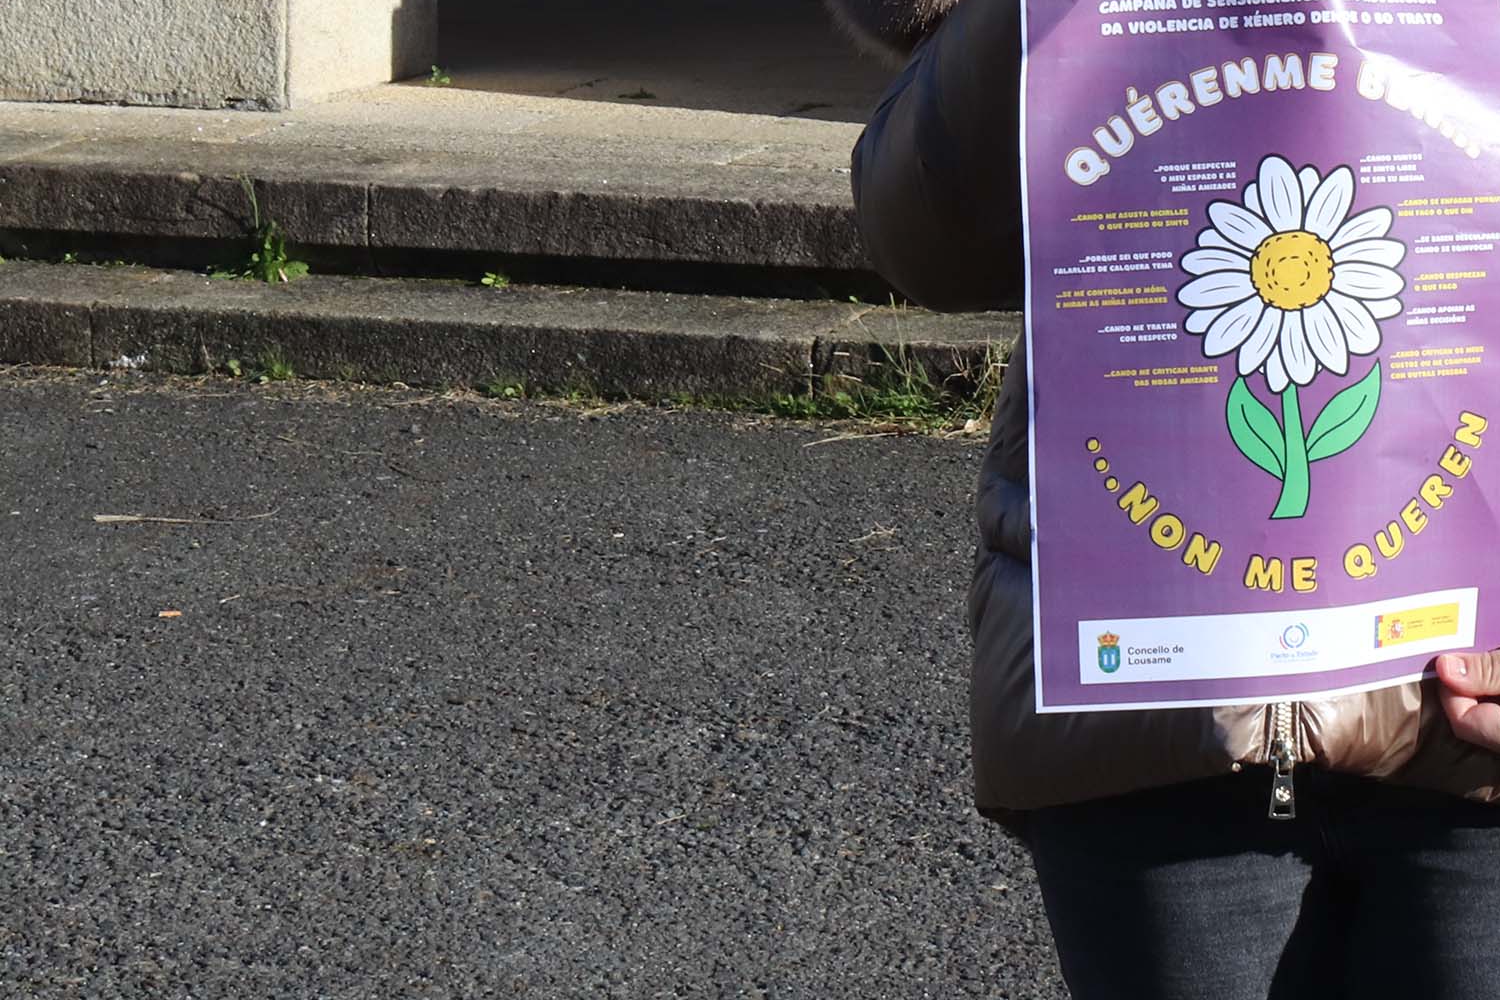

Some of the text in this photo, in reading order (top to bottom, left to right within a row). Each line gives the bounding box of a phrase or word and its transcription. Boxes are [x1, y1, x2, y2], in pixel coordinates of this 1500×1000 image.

[1101, 22, 1123, 36] DA
[1128, 18, 1214, 34] VIOLENCIA
[1219, 16, 1239, 30] DE
[1243, 10, 1306, 28] XÉNERO
[1361, 12, 1371, 24] O
[1374, 12, 1394, 25] BO
[1397, 12, 1443, 25] TRATO
[1064, 52, 1339, 186] QUÉRENME
[1192, 162, 1236, 170] RESPECTAN
[1161, 172, 1236, 183] O MEU ESPAZO E AS
[1360, 176, 1371, 184] DE
[1372, 175, 1386, 183] SER
[1388, 175, 1397, 183] EU
[1172, 182, 1237, 192] MIÑAS AMIZADES
[1105, 212, 1117, 220] ME
[1118, 210, 1148, 219] ASUSTA
[1436, 208, 1442, 216] O
[1098, 223, 1105, 231] O
[1107, 222, 1123, 231] QUE
[1124, 220, 1150, 229] PENSO
[1119, 253, 1131, 261] SEI
[1133, 252, 1149, 261] QUE
[1151, 251, 1173, 259] PODO
[1097, 265, 1108, 273] DE
[1109, 263, 1150, 272] CALQUERA
[1152, 261, 1173, 270] TEMA
[1073, 290, 1085, 298] ME
[1086, 287, 1134, 297] CONTROLAN
[1135, 286, 1141, 294] O
[1089, 299, 1099, 307] AS
[1465, 304, 1475, 312] AS
[1133, 324, 1144, 332] ME
[1146, 322, 1177, 331] TRATAN
[1119, 333, 1178, 343] CON RESPECTO
[1139, 368, 1150, 376] ME
[1152, 367, 1188, 376] CRITICAN
[1134, 379, 1149, 387] DAS
[1243, 554, 1317, 592] ME
[1343, 410, 1488, 579] QUEREN
[1127, 644, 1184, 656] Concello de
[1127, 655, 1171, 666] Lousame
